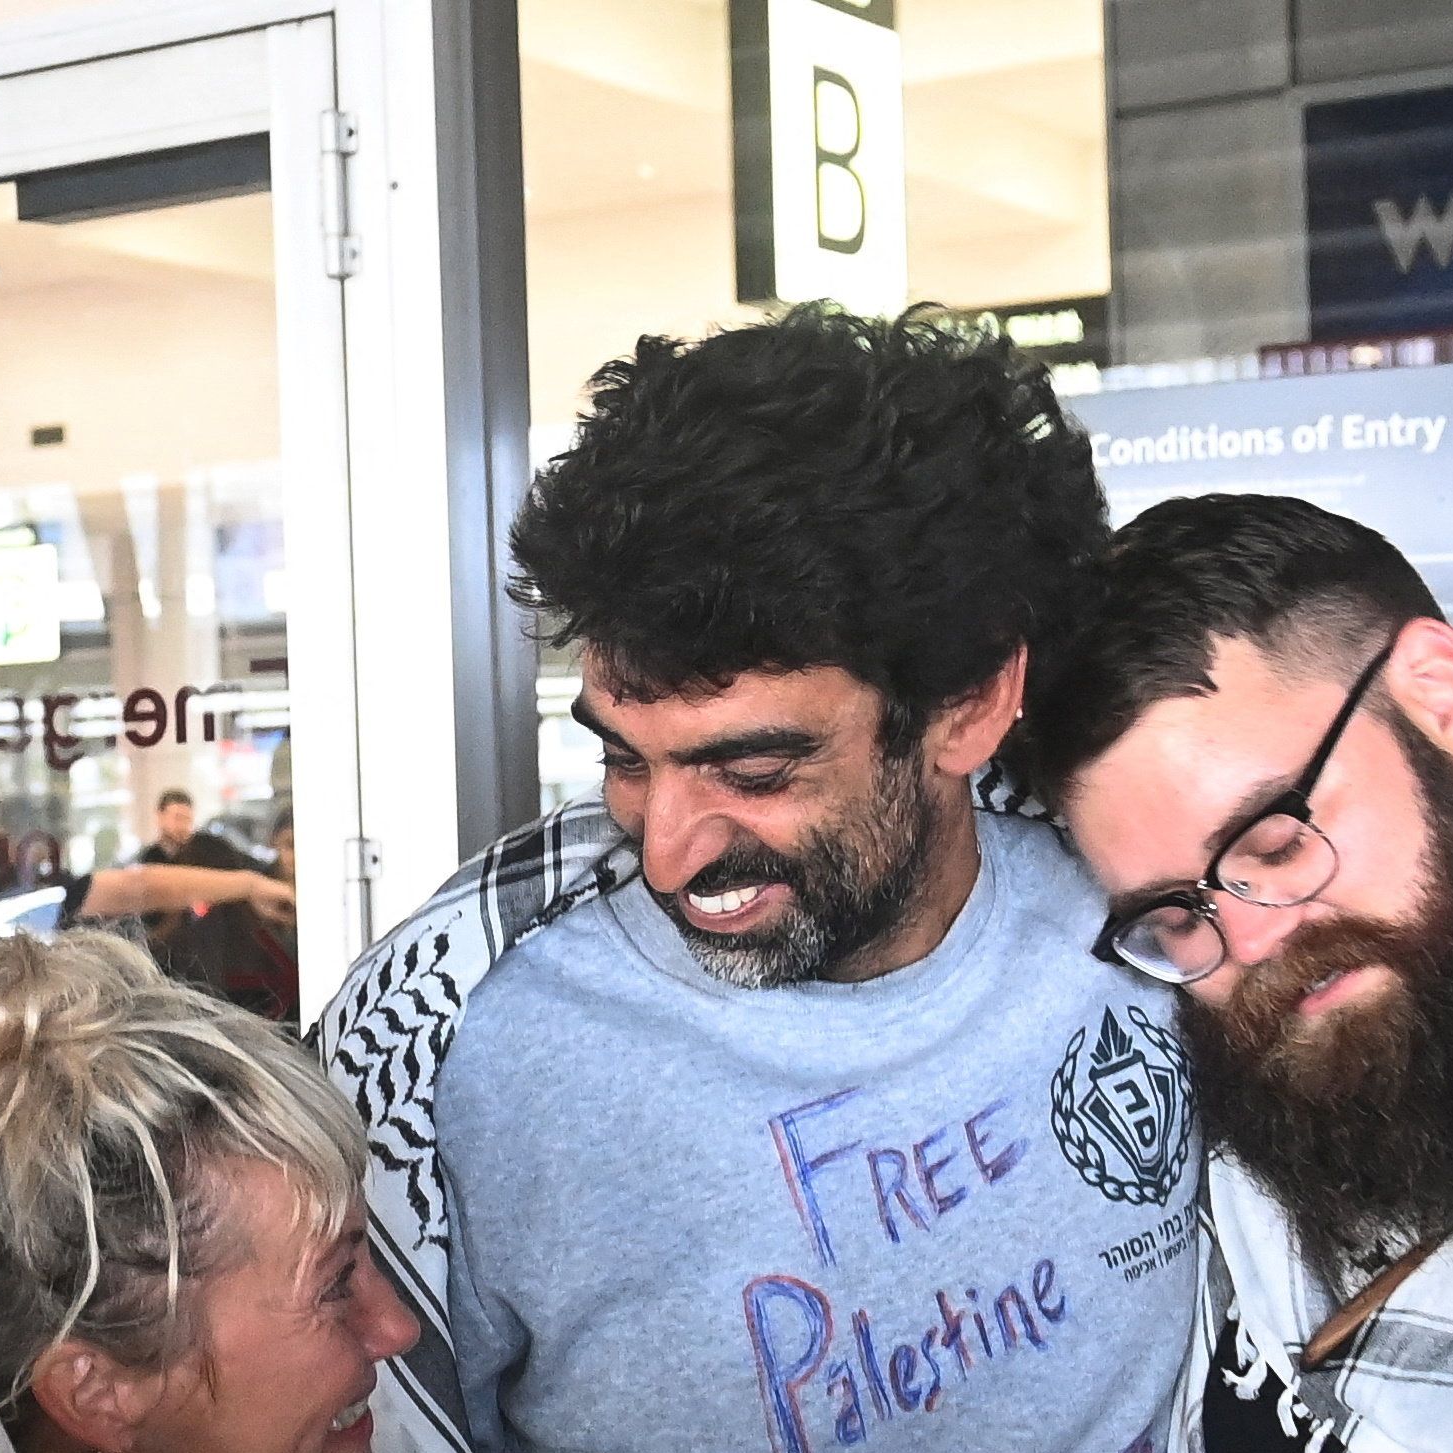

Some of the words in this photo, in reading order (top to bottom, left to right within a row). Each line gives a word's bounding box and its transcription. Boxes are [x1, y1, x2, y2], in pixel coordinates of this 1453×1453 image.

[812, 64, 866, 255] B
[1092, 424, 1284, 467] Conditions
[1291, 414, 1333, 453] of
[1341, 413, 1446, 454] Entry
[768, 1086, 1030, 1266] FREE
[1098, 1230, 1156, 1270] הסוהר
